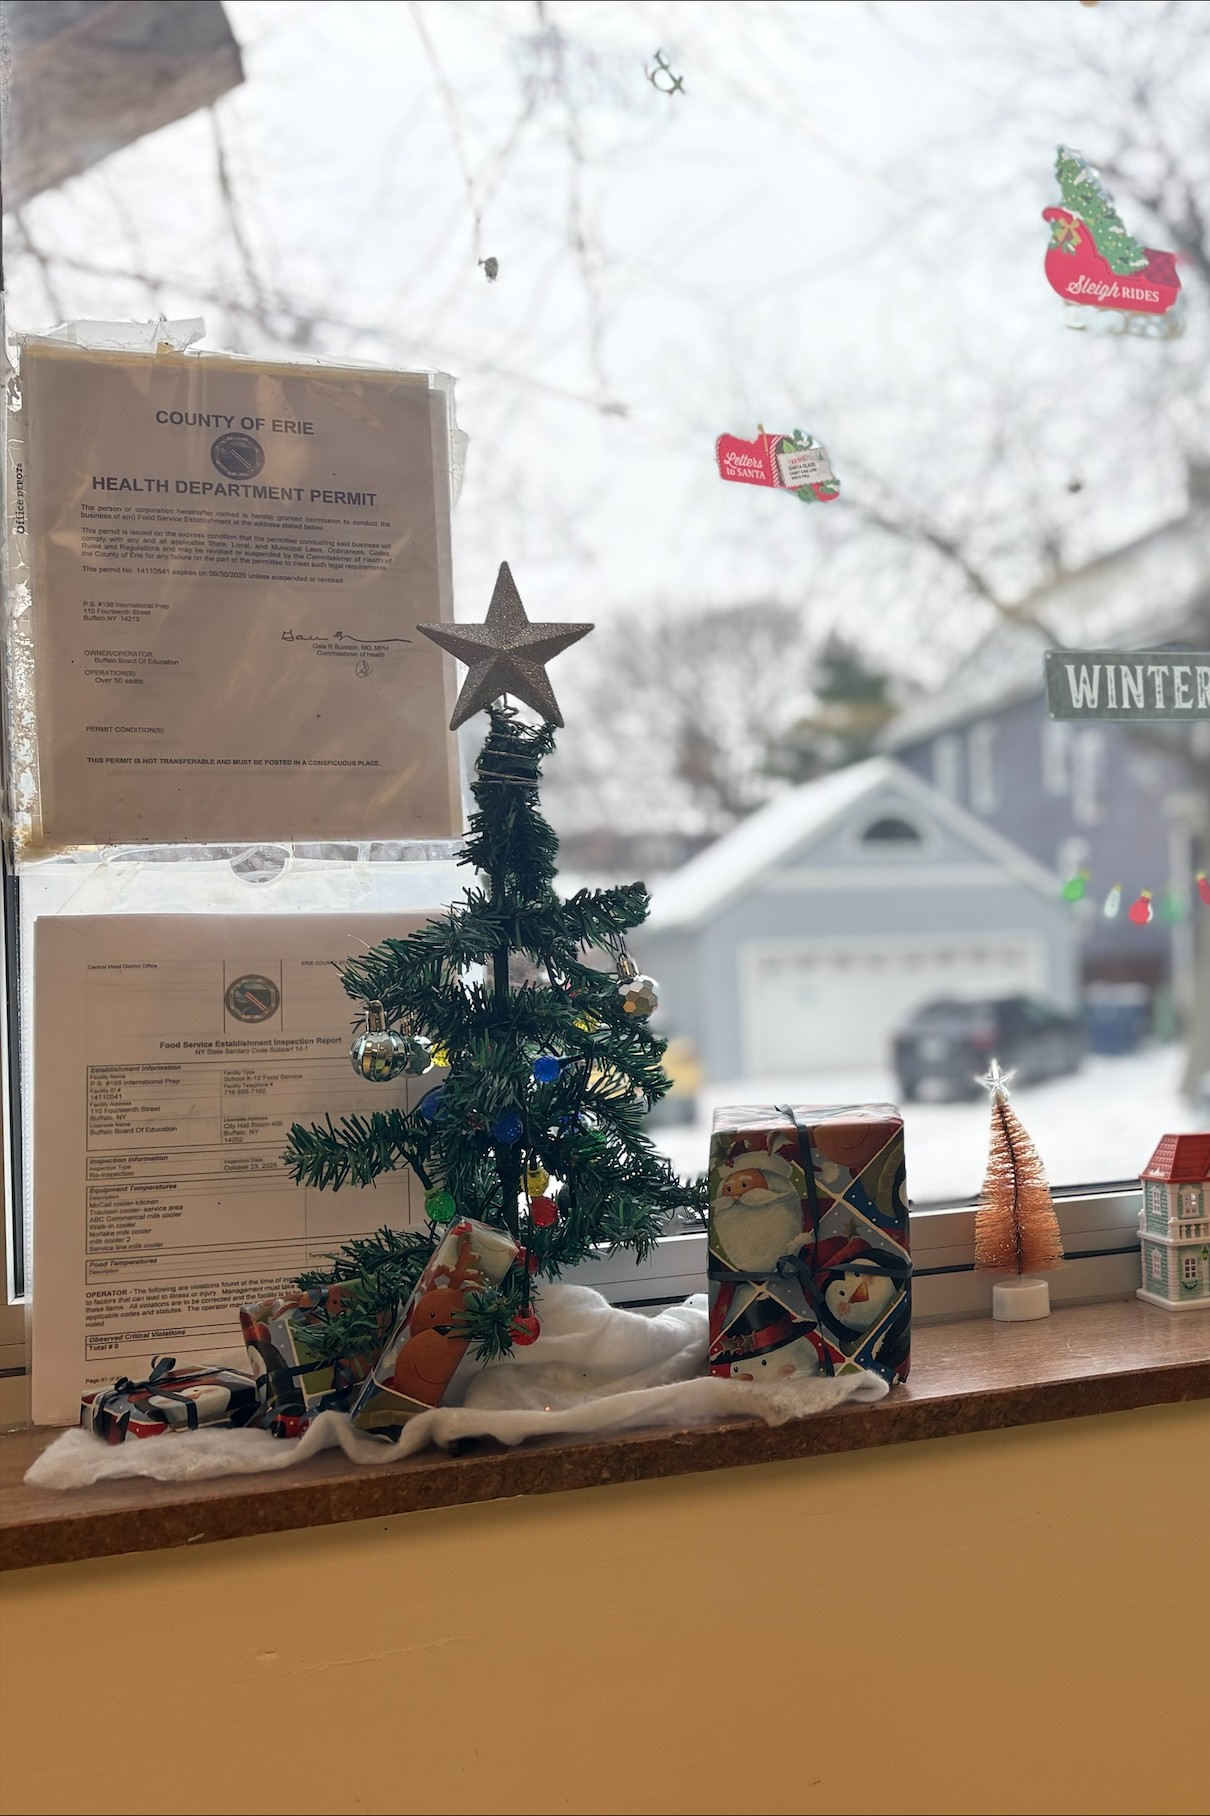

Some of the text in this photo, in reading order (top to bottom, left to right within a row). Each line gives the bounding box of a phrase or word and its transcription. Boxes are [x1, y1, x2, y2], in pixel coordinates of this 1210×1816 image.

[1065, 275, 1160, 302] Sleigh RIDES
[155, 409, 313, 435] COUNTY OF ERIE
[724, 451, 764, 470] Letters
[726, 467, 766, 480] to SANTA
[92, 475, 376, 506] HEALTH DEPARTMENT PERMIT
[16, 499, 26, 535] Office
[273, 1037, 314, 1046] Inspection
[315, 1036, 341, 1045] Report
